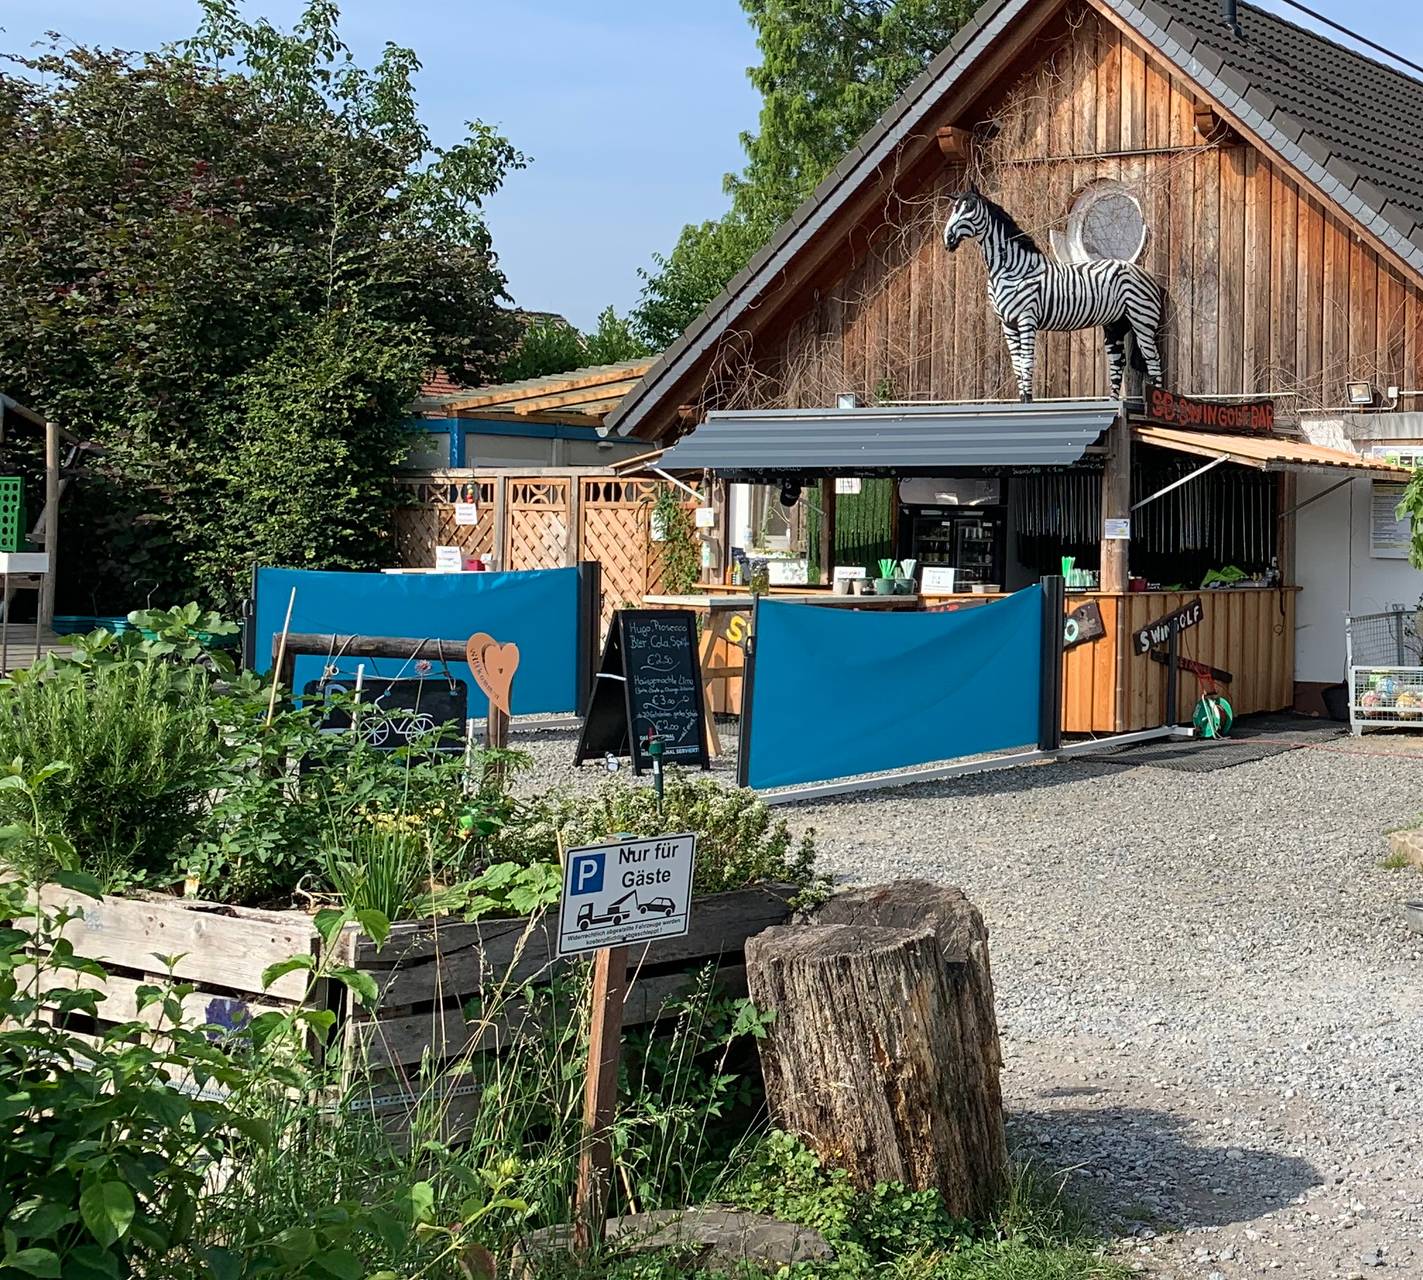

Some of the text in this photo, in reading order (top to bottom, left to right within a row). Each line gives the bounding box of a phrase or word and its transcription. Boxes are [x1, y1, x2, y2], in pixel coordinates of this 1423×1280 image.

[1250, 404, 1274, 431] BAR
[650, 619, 688, 632] Prosecco
[619, 842, 679, 865] Nur für
[578, 859, 598, 891] P
[621, 869, 671, 889] Gäste
